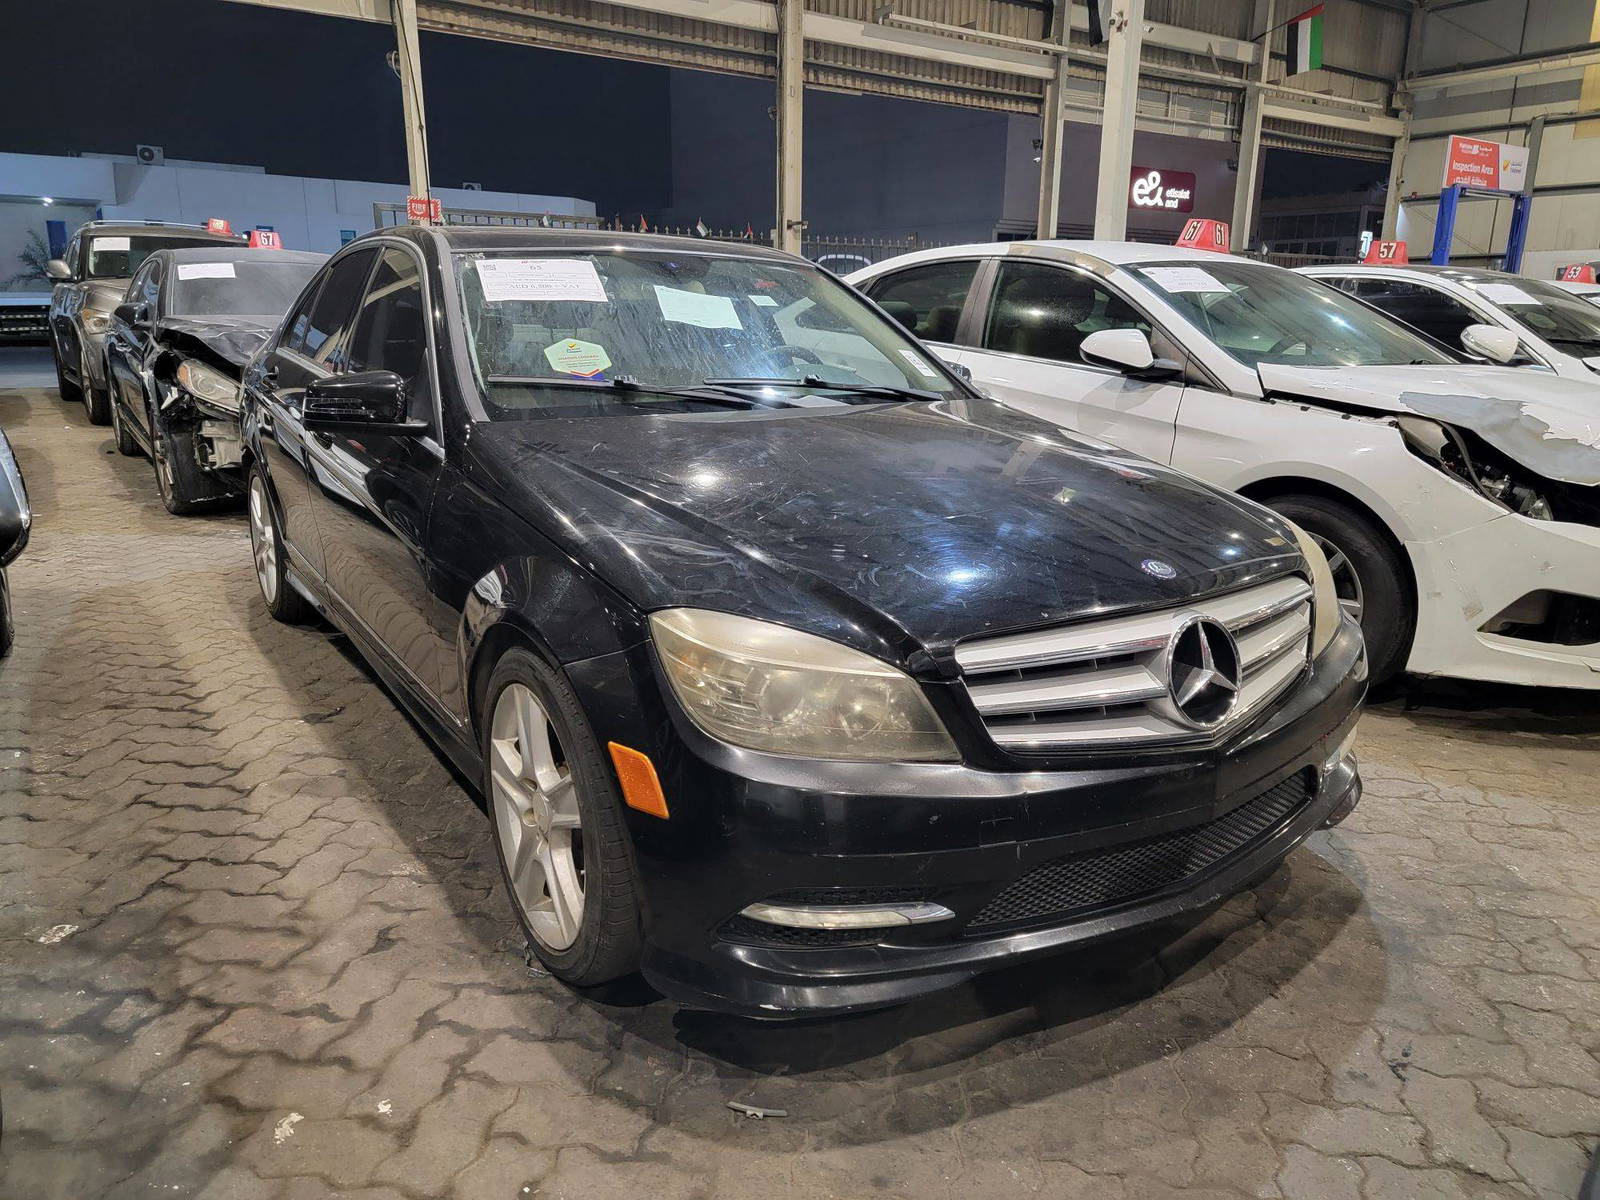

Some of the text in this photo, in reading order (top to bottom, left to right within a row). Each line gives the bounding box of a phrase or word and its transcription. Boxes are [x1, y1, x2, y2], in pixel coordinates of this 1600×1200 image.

[1453, 160, 1494, 175] Inspection Area
[1166, 188, 1190, 199] etisalat
[1165, 199, 1179, 208] and
[1184, 221, 1203, 240] 61
[1216, 223, 1225, 246] 61
[260, 233, 273, 246] 67
[1379, 242, 1397, 258] 57
[1567, 266, 1582, 279] 53
